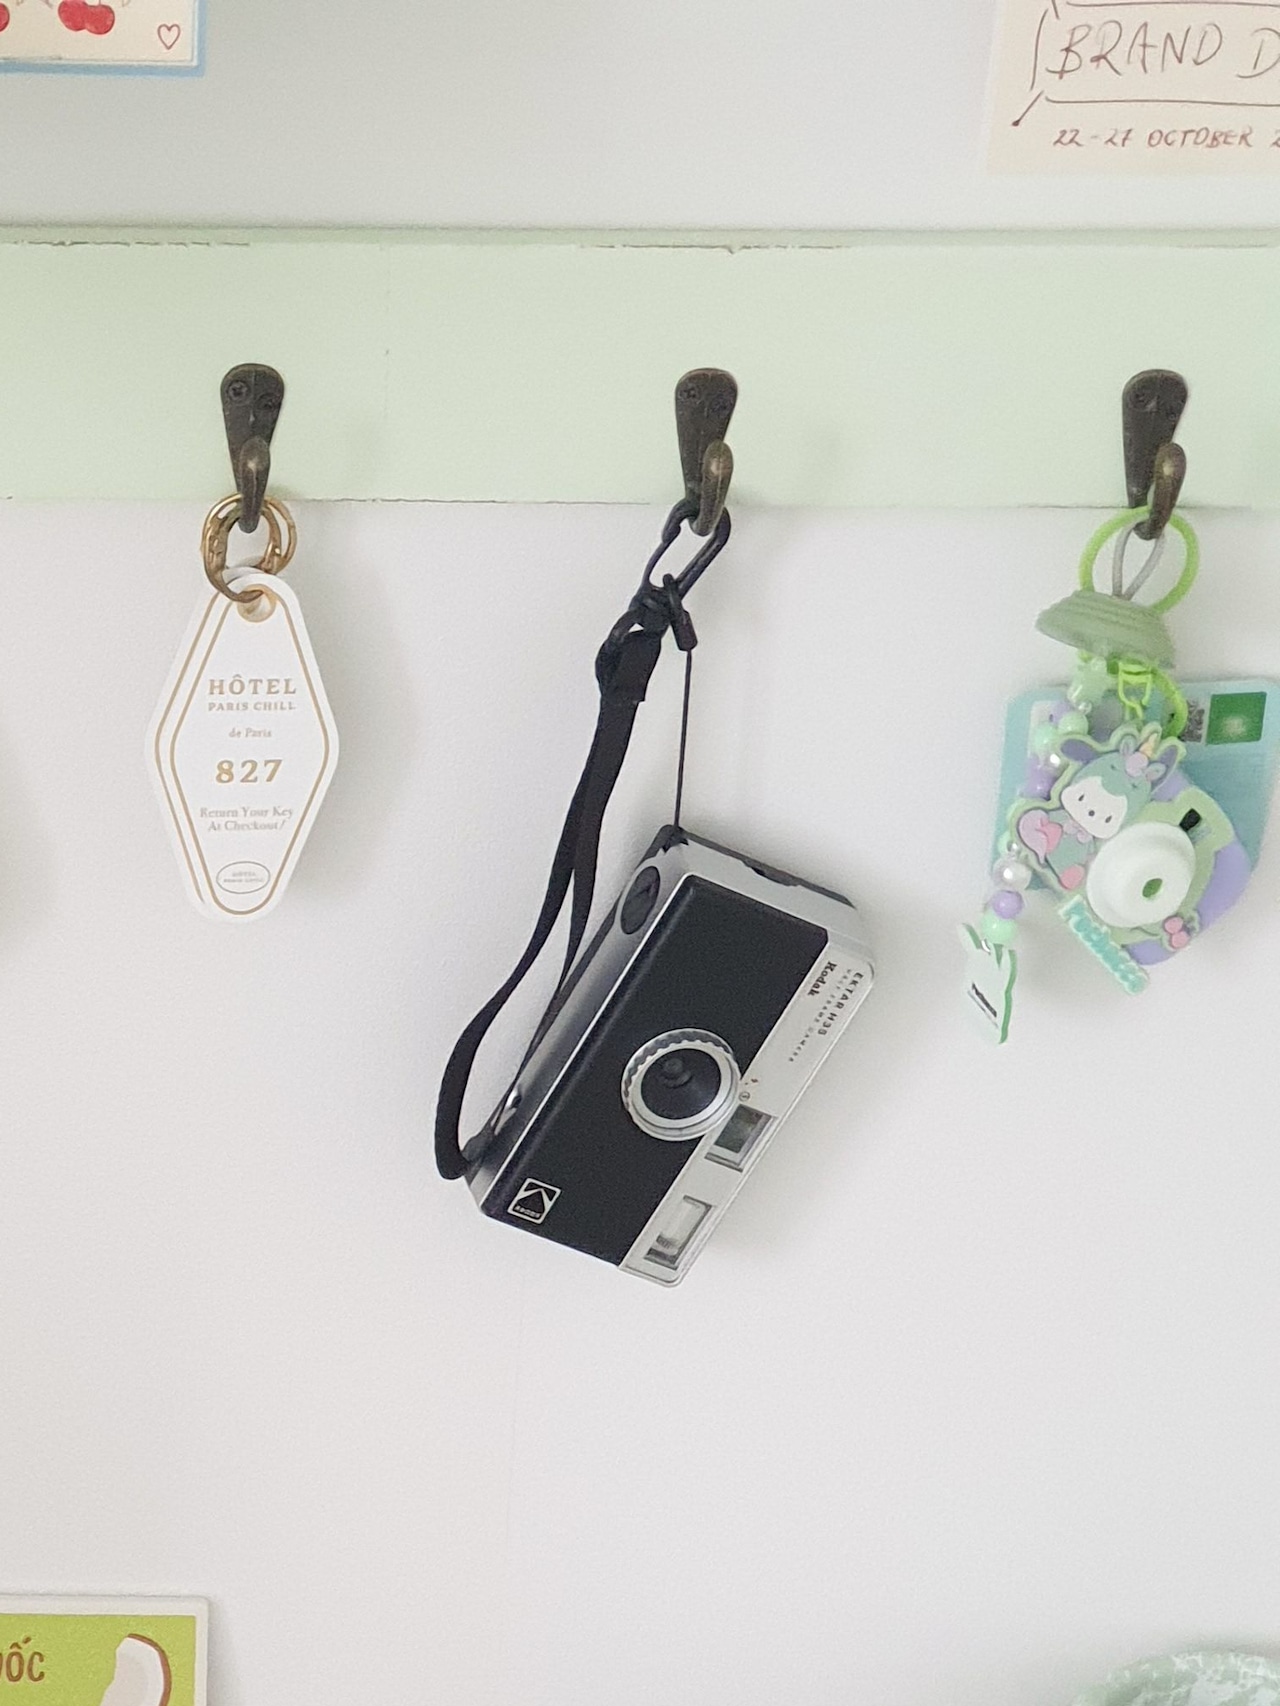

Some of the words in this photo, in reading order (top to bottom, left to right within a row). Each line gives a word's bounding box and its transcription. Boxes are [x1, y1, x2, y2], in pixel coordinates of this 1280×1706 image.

[1045, 20, 1223, 80] BRAND
[1147, 126, 1253, 149] OCTOBER
[209, 673, 297, 696] HÔTEL
[208, 701, 249, 712] PARIS
[253, 701, 297, 711] CHILL
[228, 727, 241, 738] de
[245, 727, 272, 738] Paris
[215, 759, 283, 784] 827
[200, 807, 238, 818] Return
[241, 806, 269, 817] Your
[272, 805, 293, 819] Key
[807, 961, 838, 997] Kodak
[835, 972, 864, 1010] EKTAR
